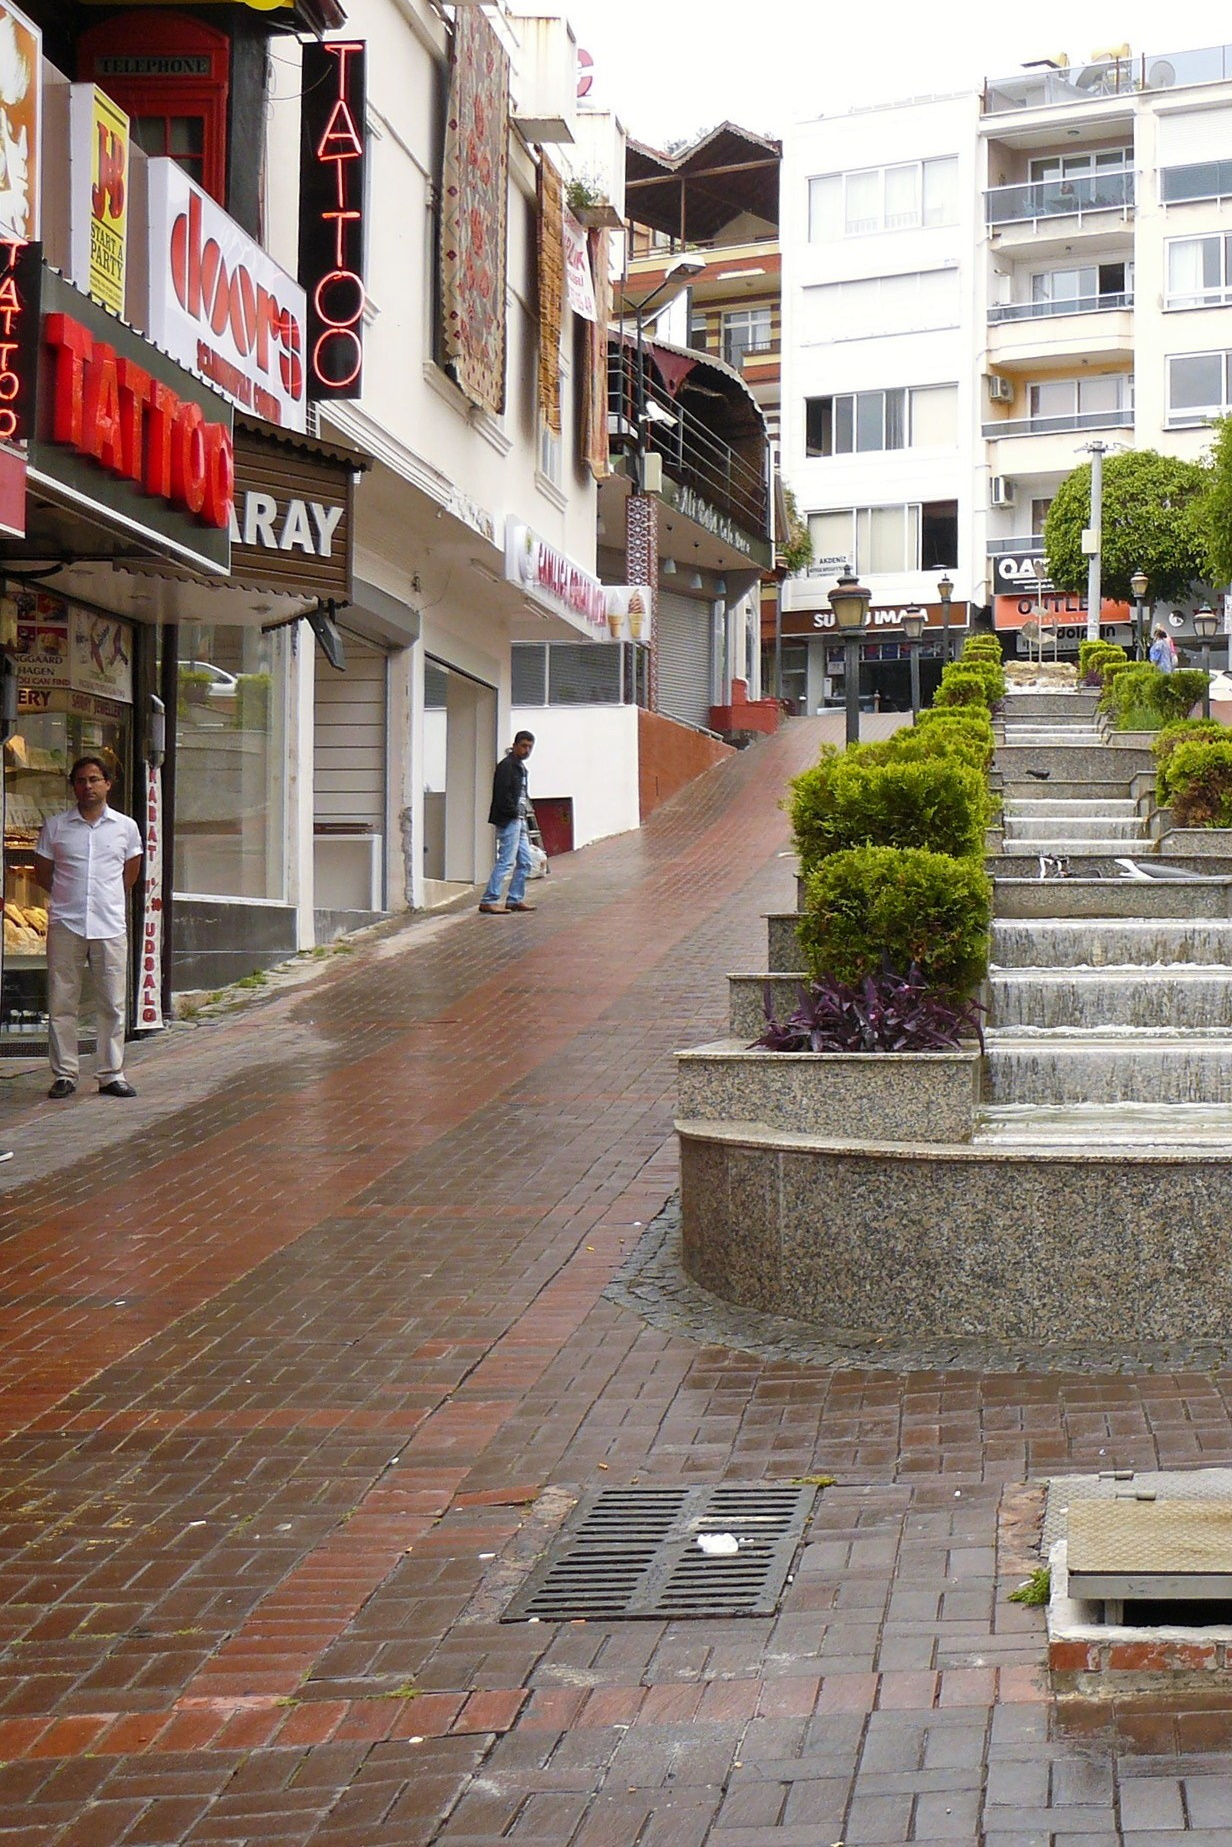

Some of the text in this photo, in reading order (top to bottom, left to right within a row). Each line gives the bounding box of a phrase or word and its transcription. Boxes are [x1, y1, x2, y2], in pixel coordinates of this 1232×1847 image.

[102, 57, 210, 74] TELEPHONE
[314, 44, 366, 387] TATTOO
[90, 221, 116, 253] START
[90, 239, 123, 281] PARTY
[0, 238, 29, 436] TATTOO
[46, 312, 234, 529] TATTOO
[1018, 596, 1102, 615] OTLE
[1056, 625, 1116, 641] dolpin
[142, 922, 156, 1023] UDSALG
